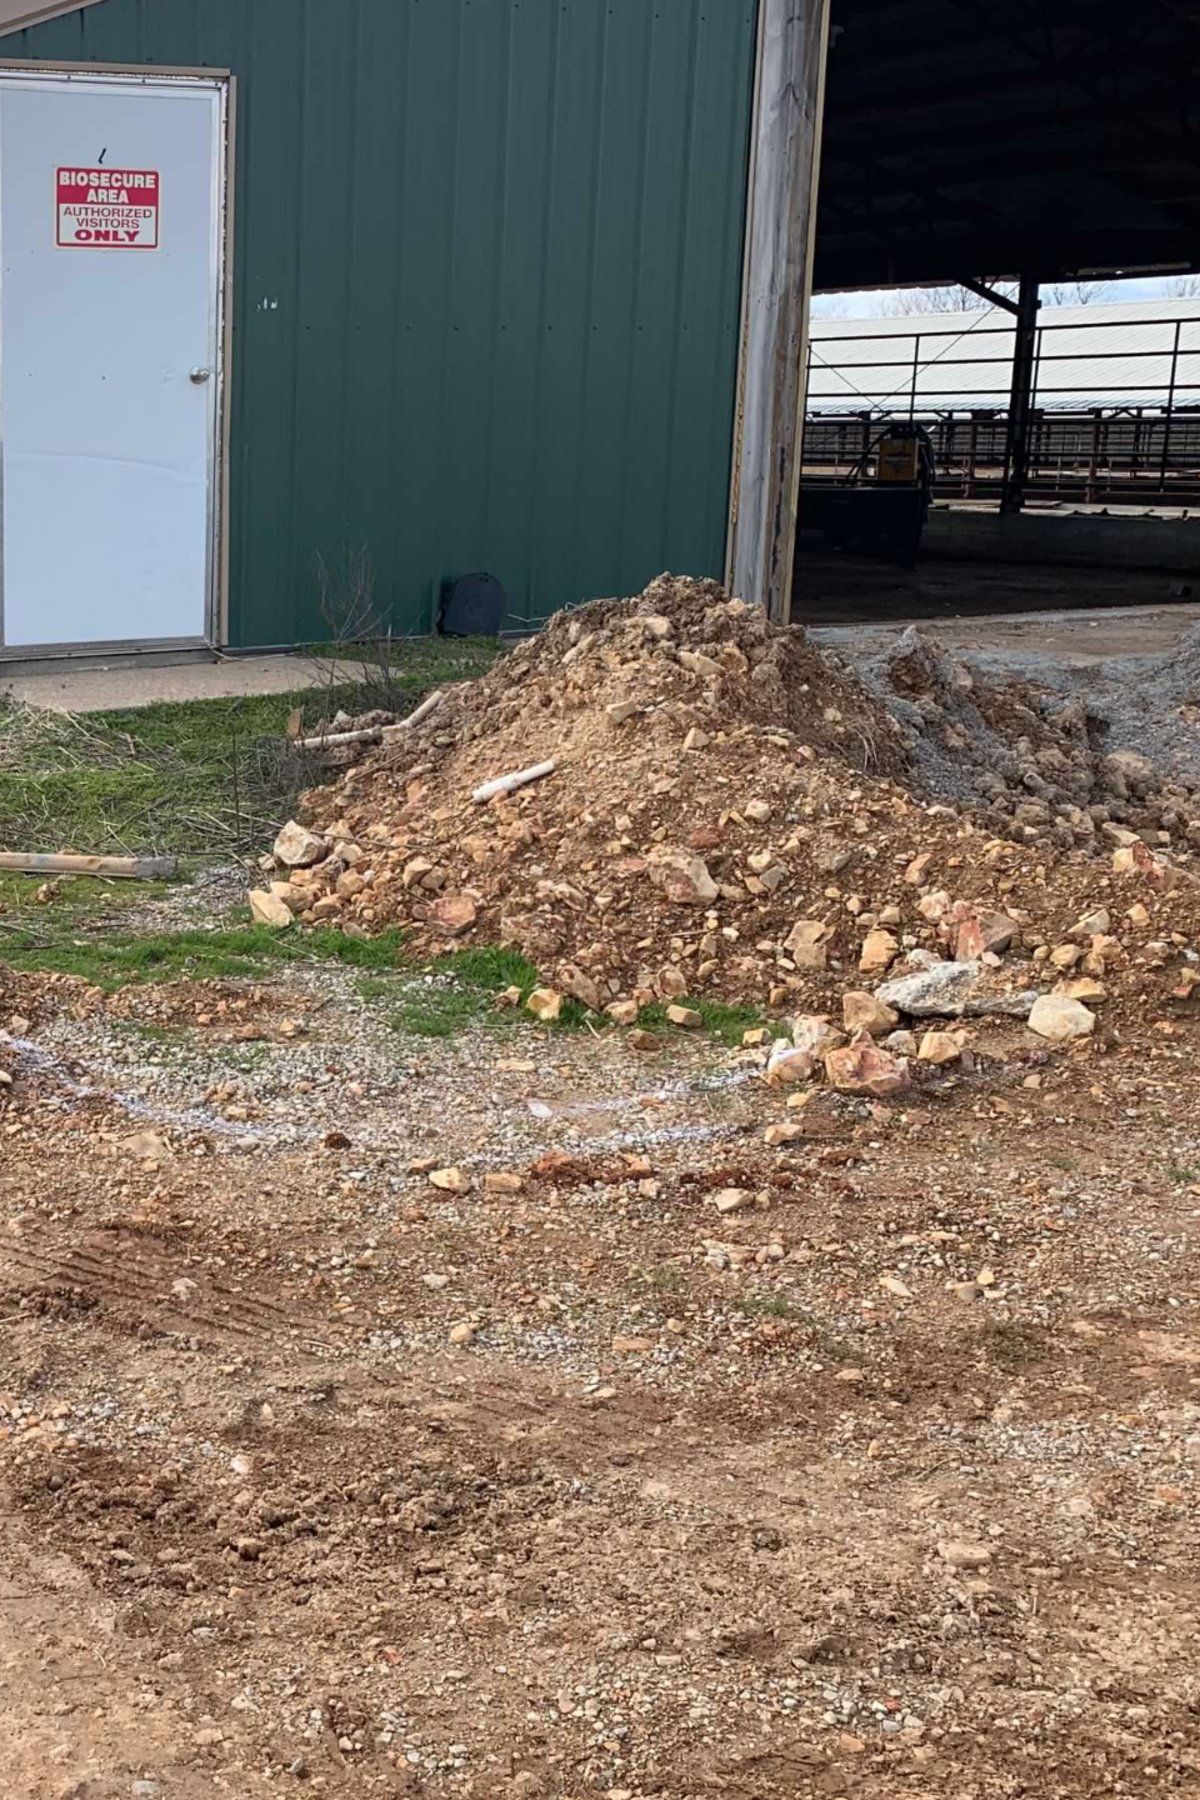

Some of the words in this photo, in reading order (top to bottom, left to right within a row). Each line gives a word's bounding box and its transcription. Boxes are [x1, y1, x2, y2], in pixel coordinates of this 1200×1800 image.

[59, 171, 156, 189] BIOSECURE
[86, 188, 129, 204] AREA
[63, 206, 153, 219] AUTHORIZED
[76, 217, 140, 229] VISITORS
[74, 229, 140, 242] ONLY
